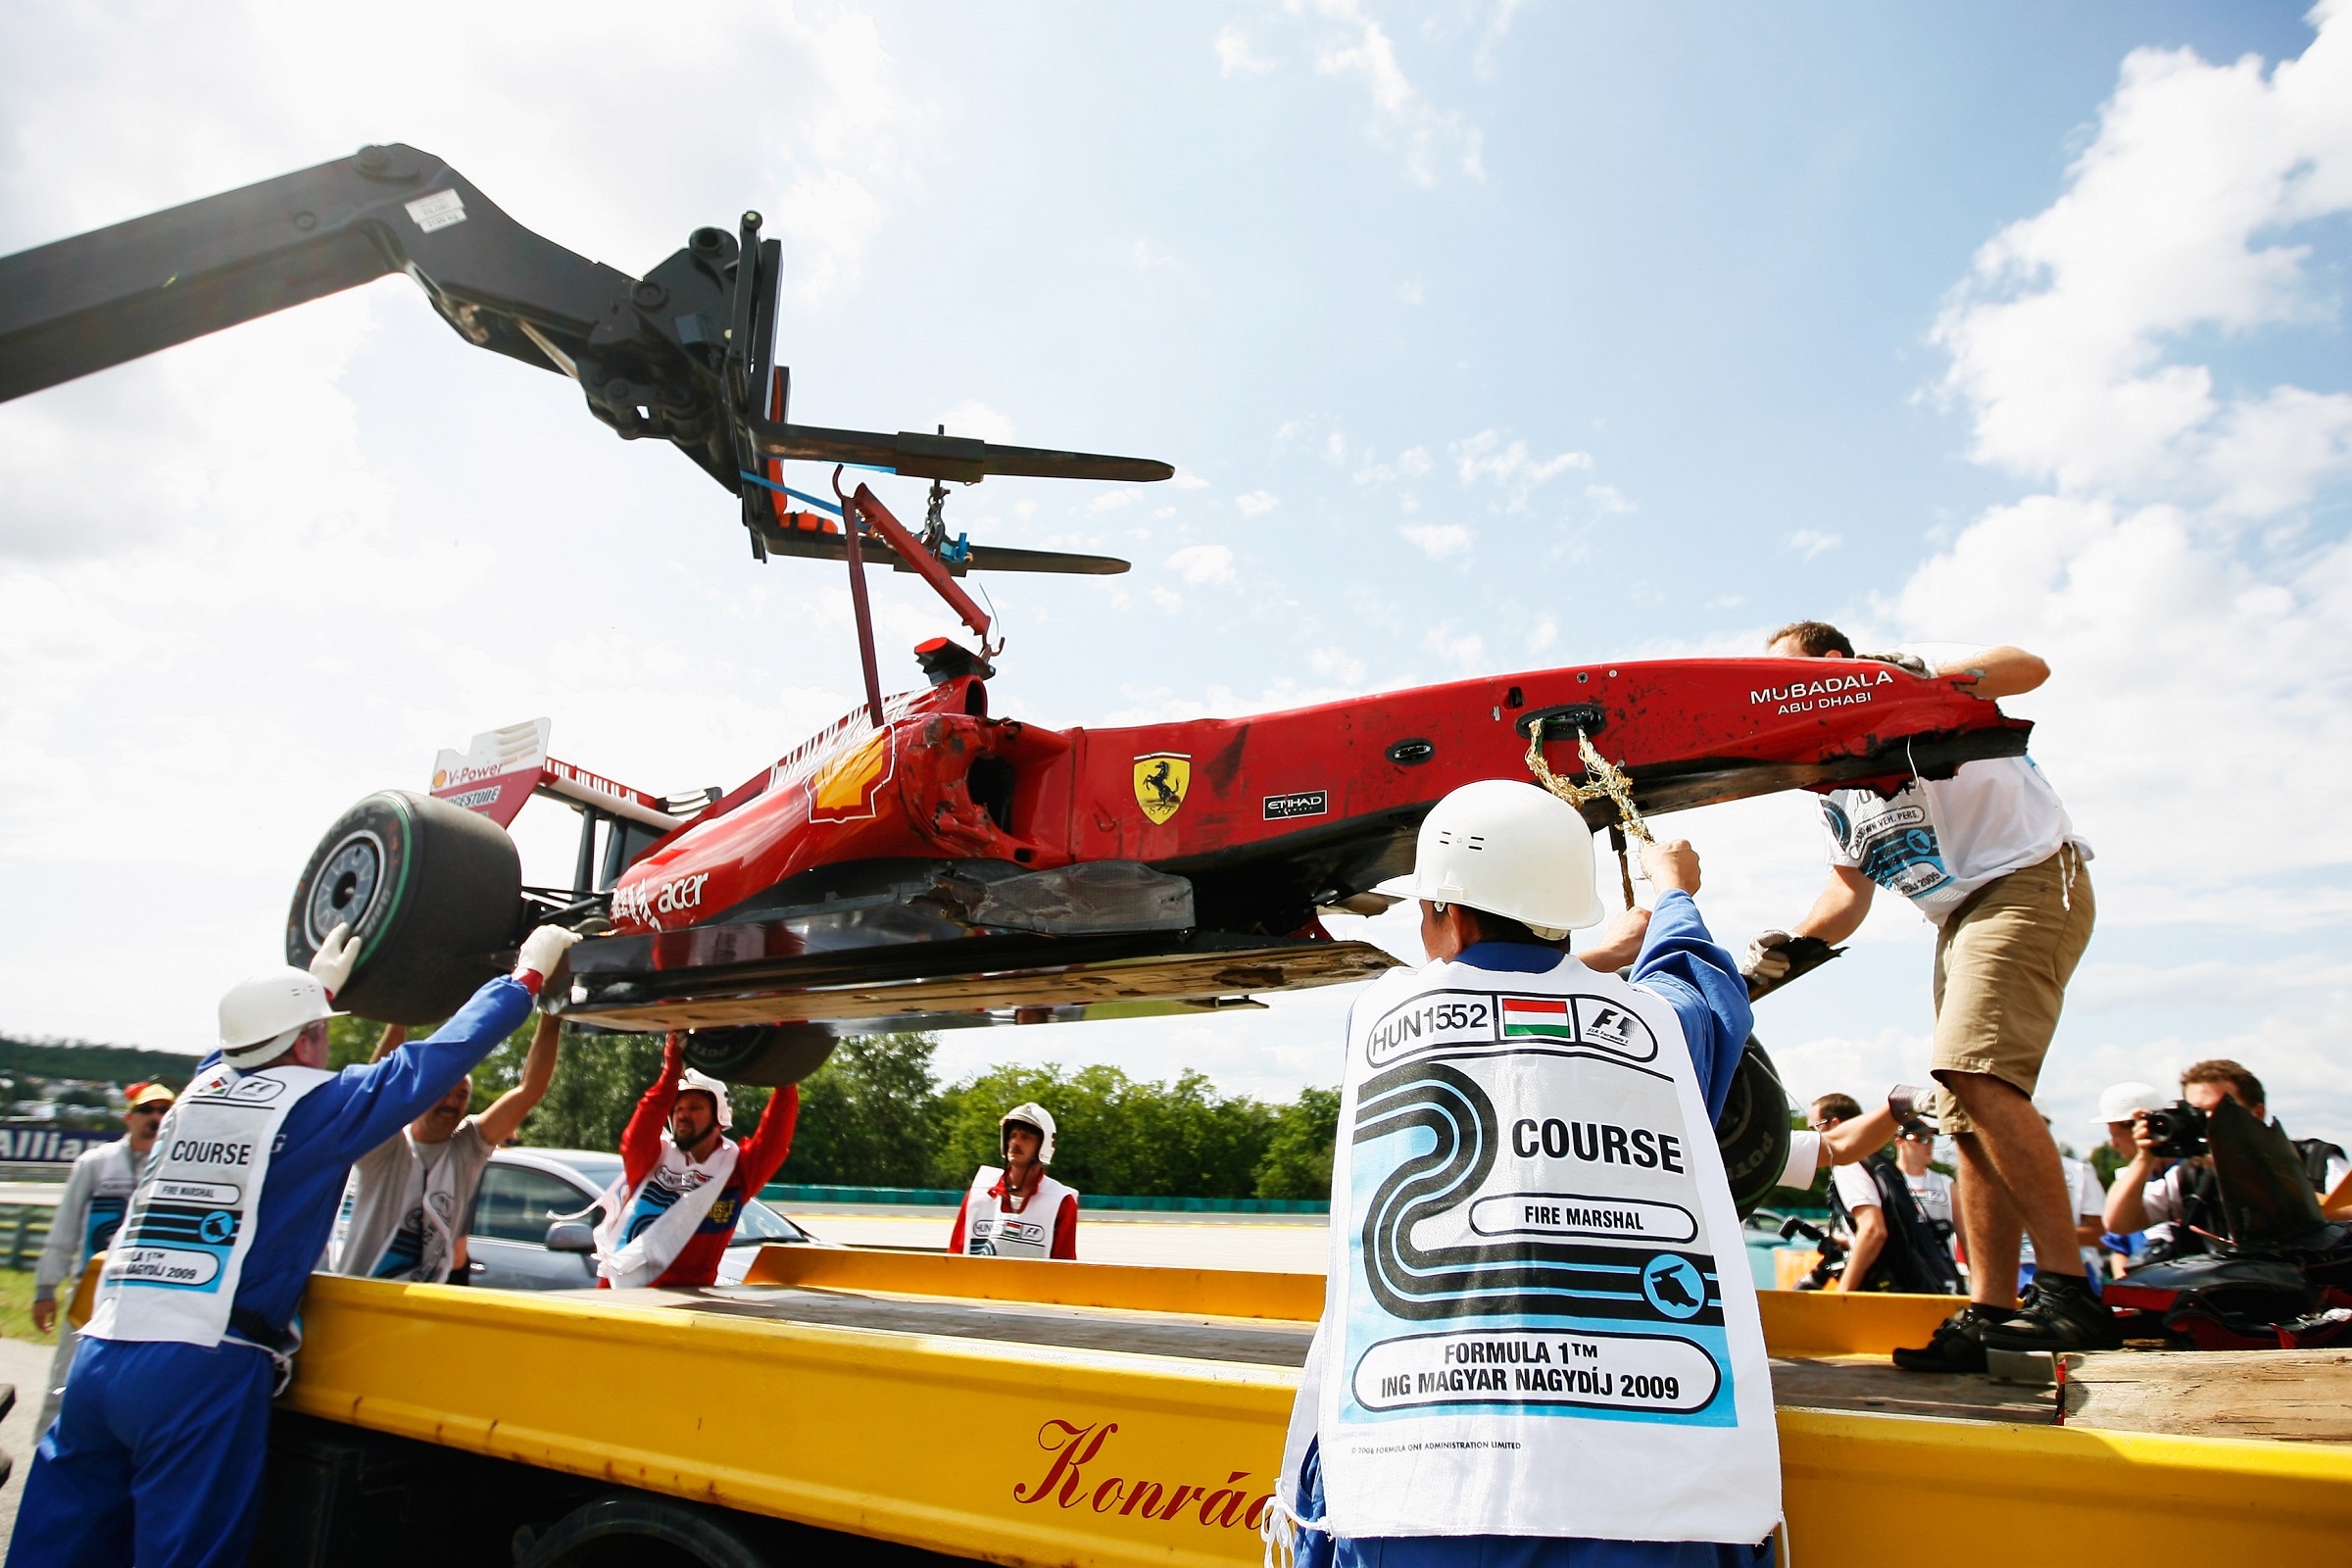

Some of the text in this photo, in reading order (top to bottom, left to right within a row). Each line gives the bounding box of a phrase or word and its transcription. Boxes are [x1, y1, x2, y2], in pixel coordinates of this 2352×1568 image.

[1750, 670, 1893, 704] MUBADALA
[1778, 692, 1872, 714] ABU DHABI
[449, 764, 503, 784] V-Power
[1268, 797, 1322, 809] ETIHAD
[658, 872, 710, 913] acer
[1372, 1004, 1488, 1055] HUN1552
[171, 1140, 252, 1165] COURSE
[1512, 1118, 1684, 1174] COURSE
[162, 1186, 215, 1199] FIRE MARSHAL
[1525, 1205, 1644, 1231] FIRE MARSHAL
[167, 1267, 197, 1280] 2009
[1444, 1342, 1549, 1365] FORMULA
[1381, 1366, 1680, 1399] ING MAGYAR NAGYDÍJ 2009
[1376, 1446, 1406, 1454] FORMULA
[1424, 1442, 1489, 1450] ADMINISTRATION
[1491, 1442, 1522, 1450] LIMITED
